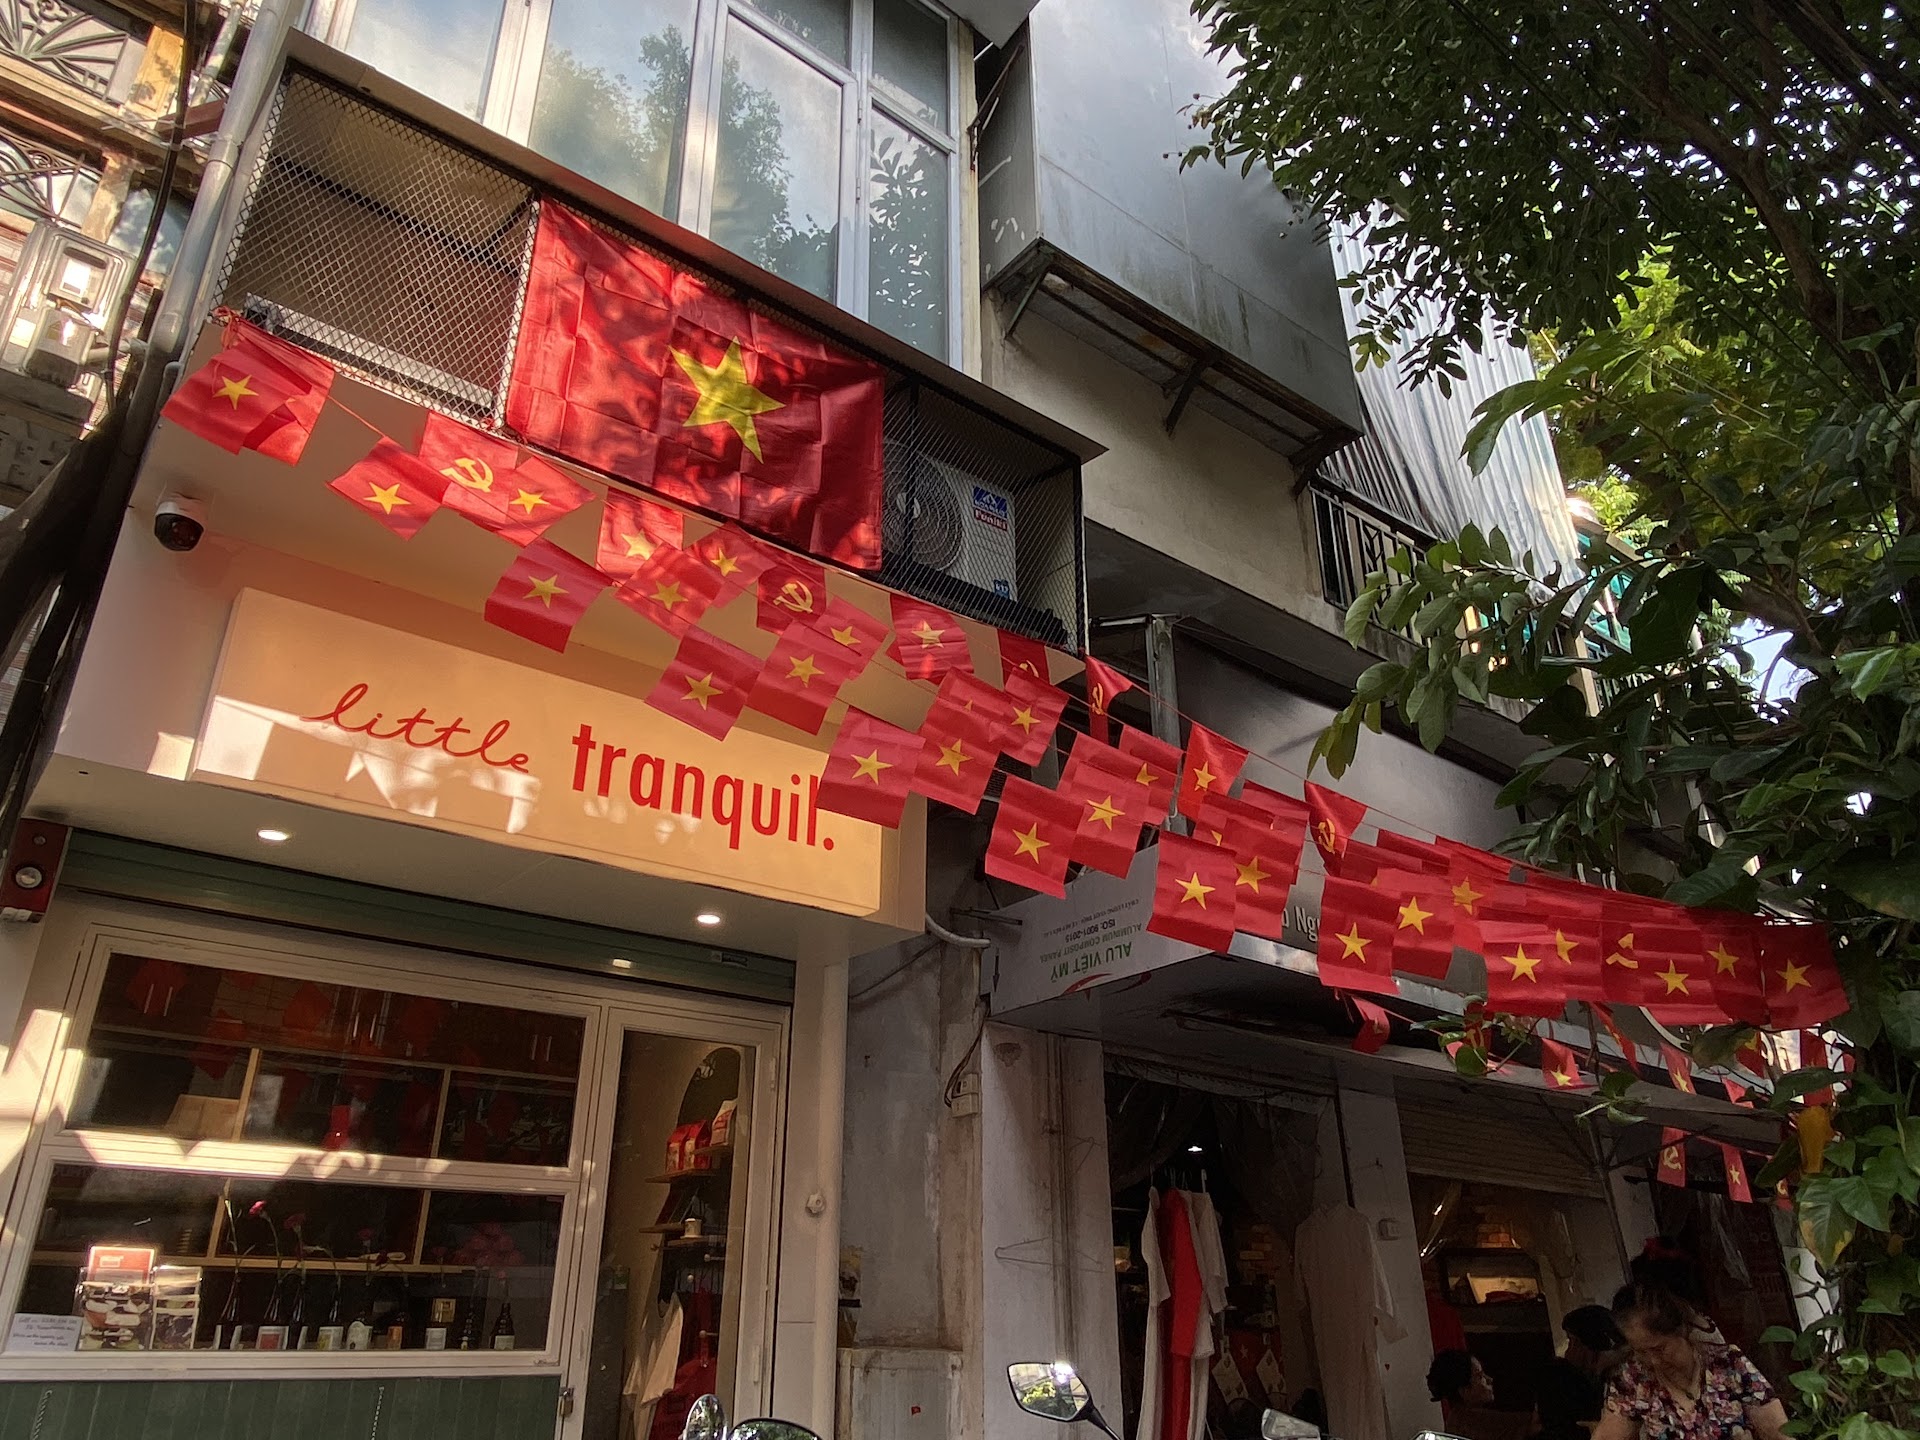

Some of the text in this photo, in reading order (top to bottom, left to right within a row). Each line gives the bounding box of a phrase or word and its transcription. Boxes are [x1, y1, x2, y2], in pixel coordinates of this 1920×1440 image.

[300, 682, 835, 851] little tranquil.
[1065, 924, 1099, 943] 9001-2015
[1100, 918, 1116, 930] ISO:
[1102, 923, 1142, 943] ALUMINUM
[1050, 941, 1132, 983] ALU VIỆT MỸ
